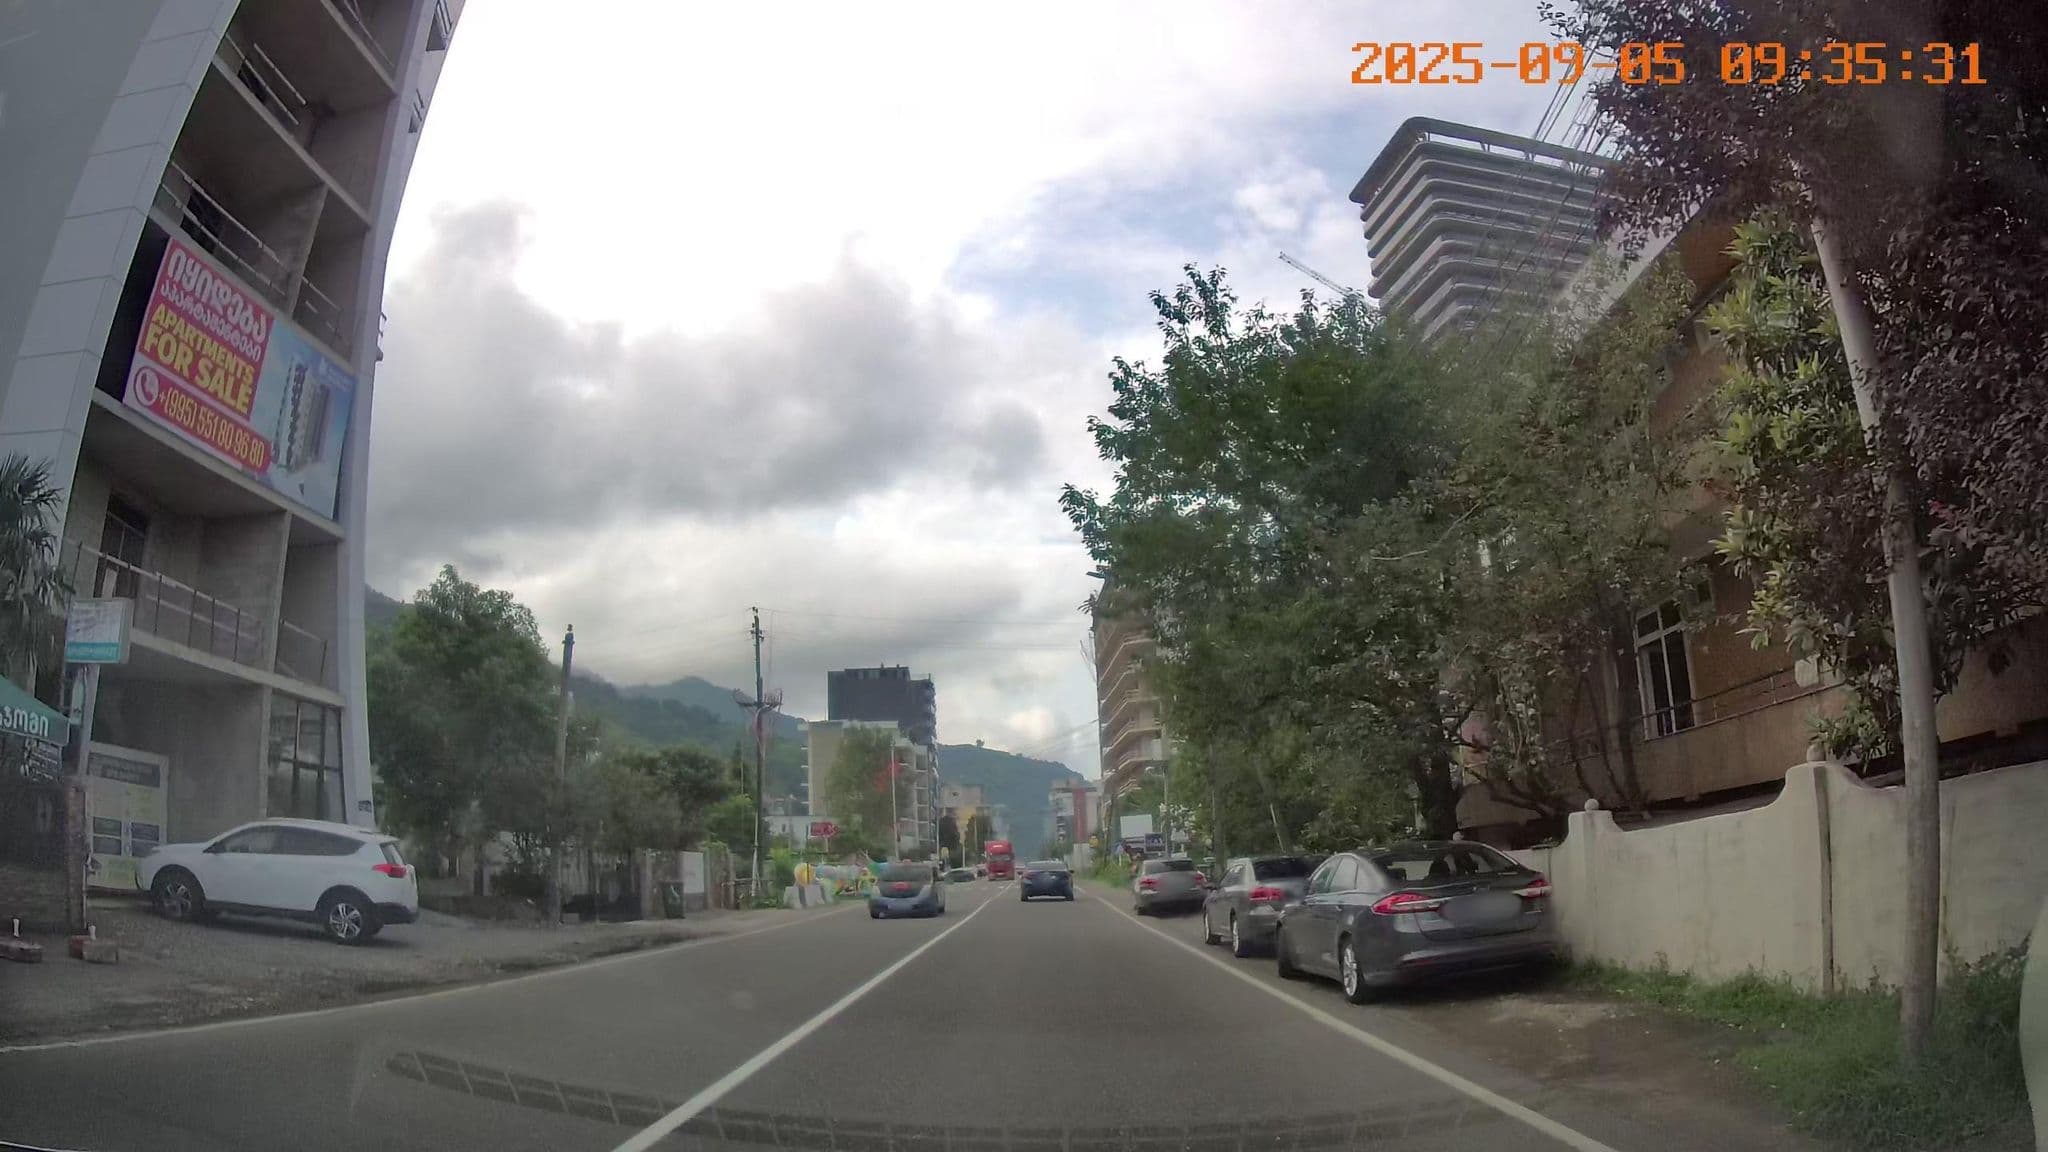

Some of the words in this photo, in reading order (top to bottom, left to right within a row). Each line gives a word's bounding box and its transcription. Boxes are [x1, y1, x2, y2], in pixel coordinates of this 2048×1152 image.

[167, 249, 267, 343] იყიდება
[144, 326, 196, 378] FOR
[195, 361, 254, 415] SALE
[152, 303, 255, 384] APARTMENTS
